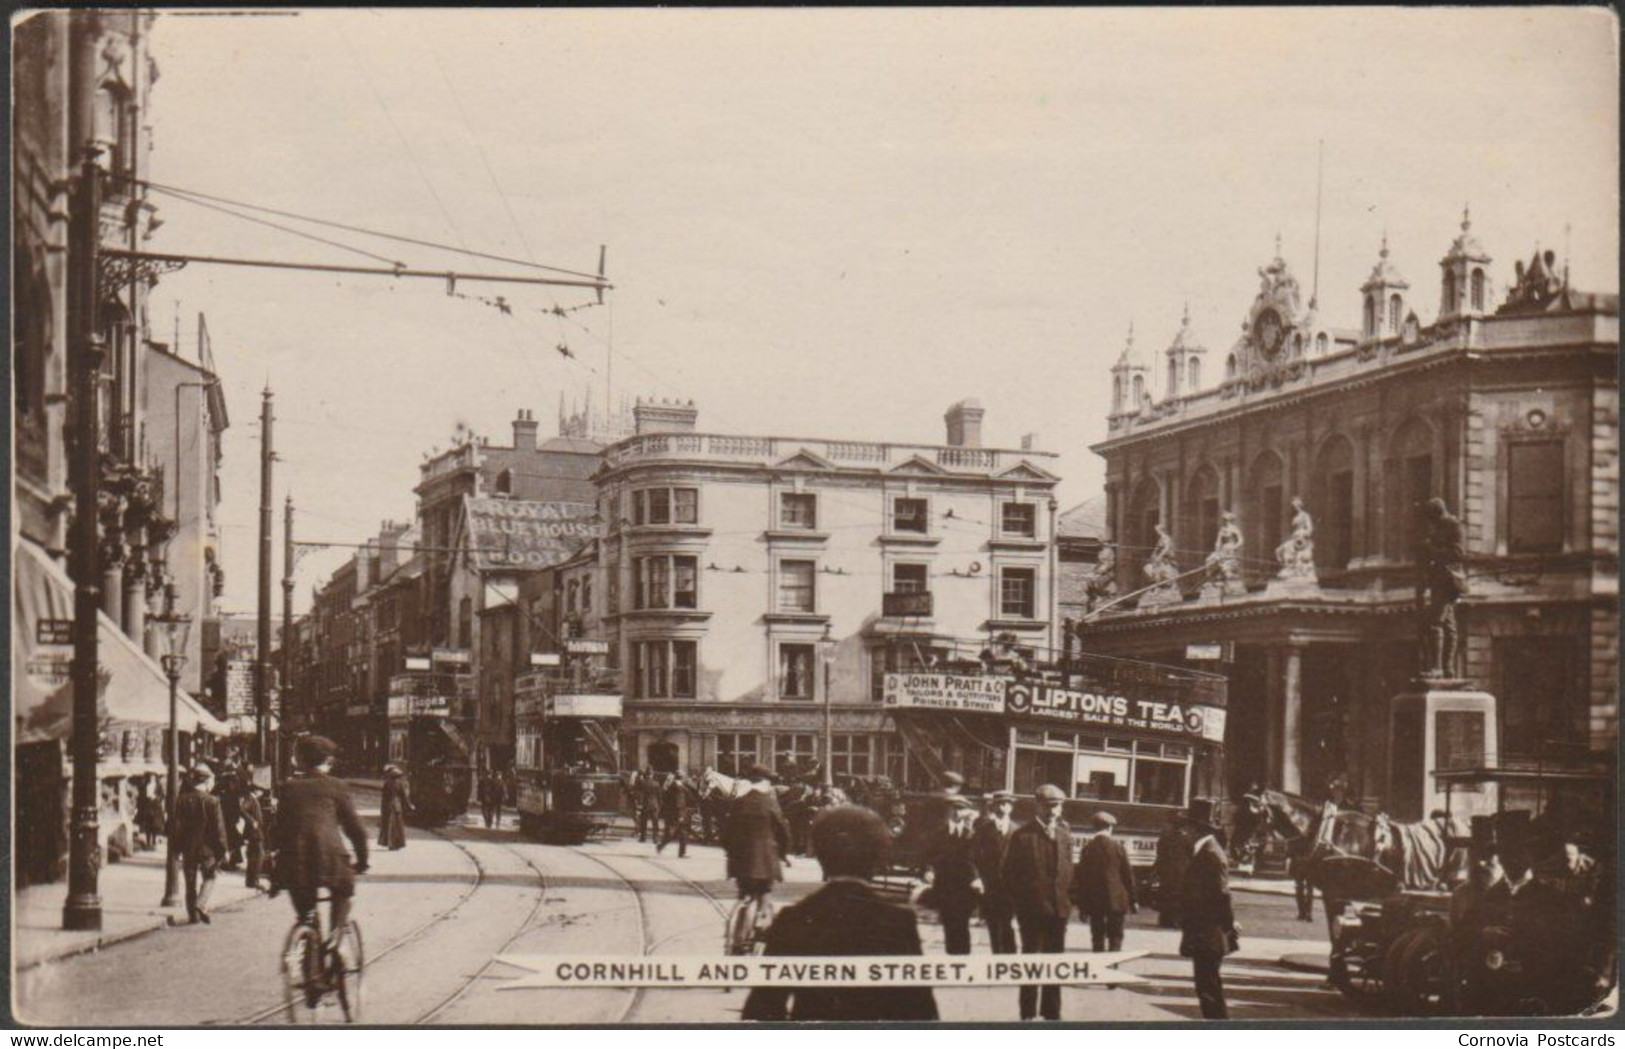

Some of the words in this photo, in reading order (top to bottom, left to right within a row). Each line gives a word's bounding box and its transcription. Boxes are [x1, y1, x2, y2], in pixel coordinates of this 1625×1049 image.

[472, 517, 532, 536] BLUE
[535, 521, 601, 539] HOUSE
[903, 674, 940, 689] JOHN
[945, 676, 982, 692] PRATT
[985, 681, 992, 692] &
[906, 688, 944, 698] TAILORS
[957, 691, 1001, 702] OUTFITTERS
[912, 696, 958, 707] PRINCES
[962, 699, 995, 709] STREET
[1031, 686, 1128, 717] LIPTON'S
[1137, 700, 1185, 723] TEA
[1030, 707, 1080, 720] LARGEST
[1083, 712, 1110, 724] SALE
[1113, 716, 1124, 725] IN
[1127, 718, 1148, 729] THE
[1149, 720, 1185, 733] WORLD
